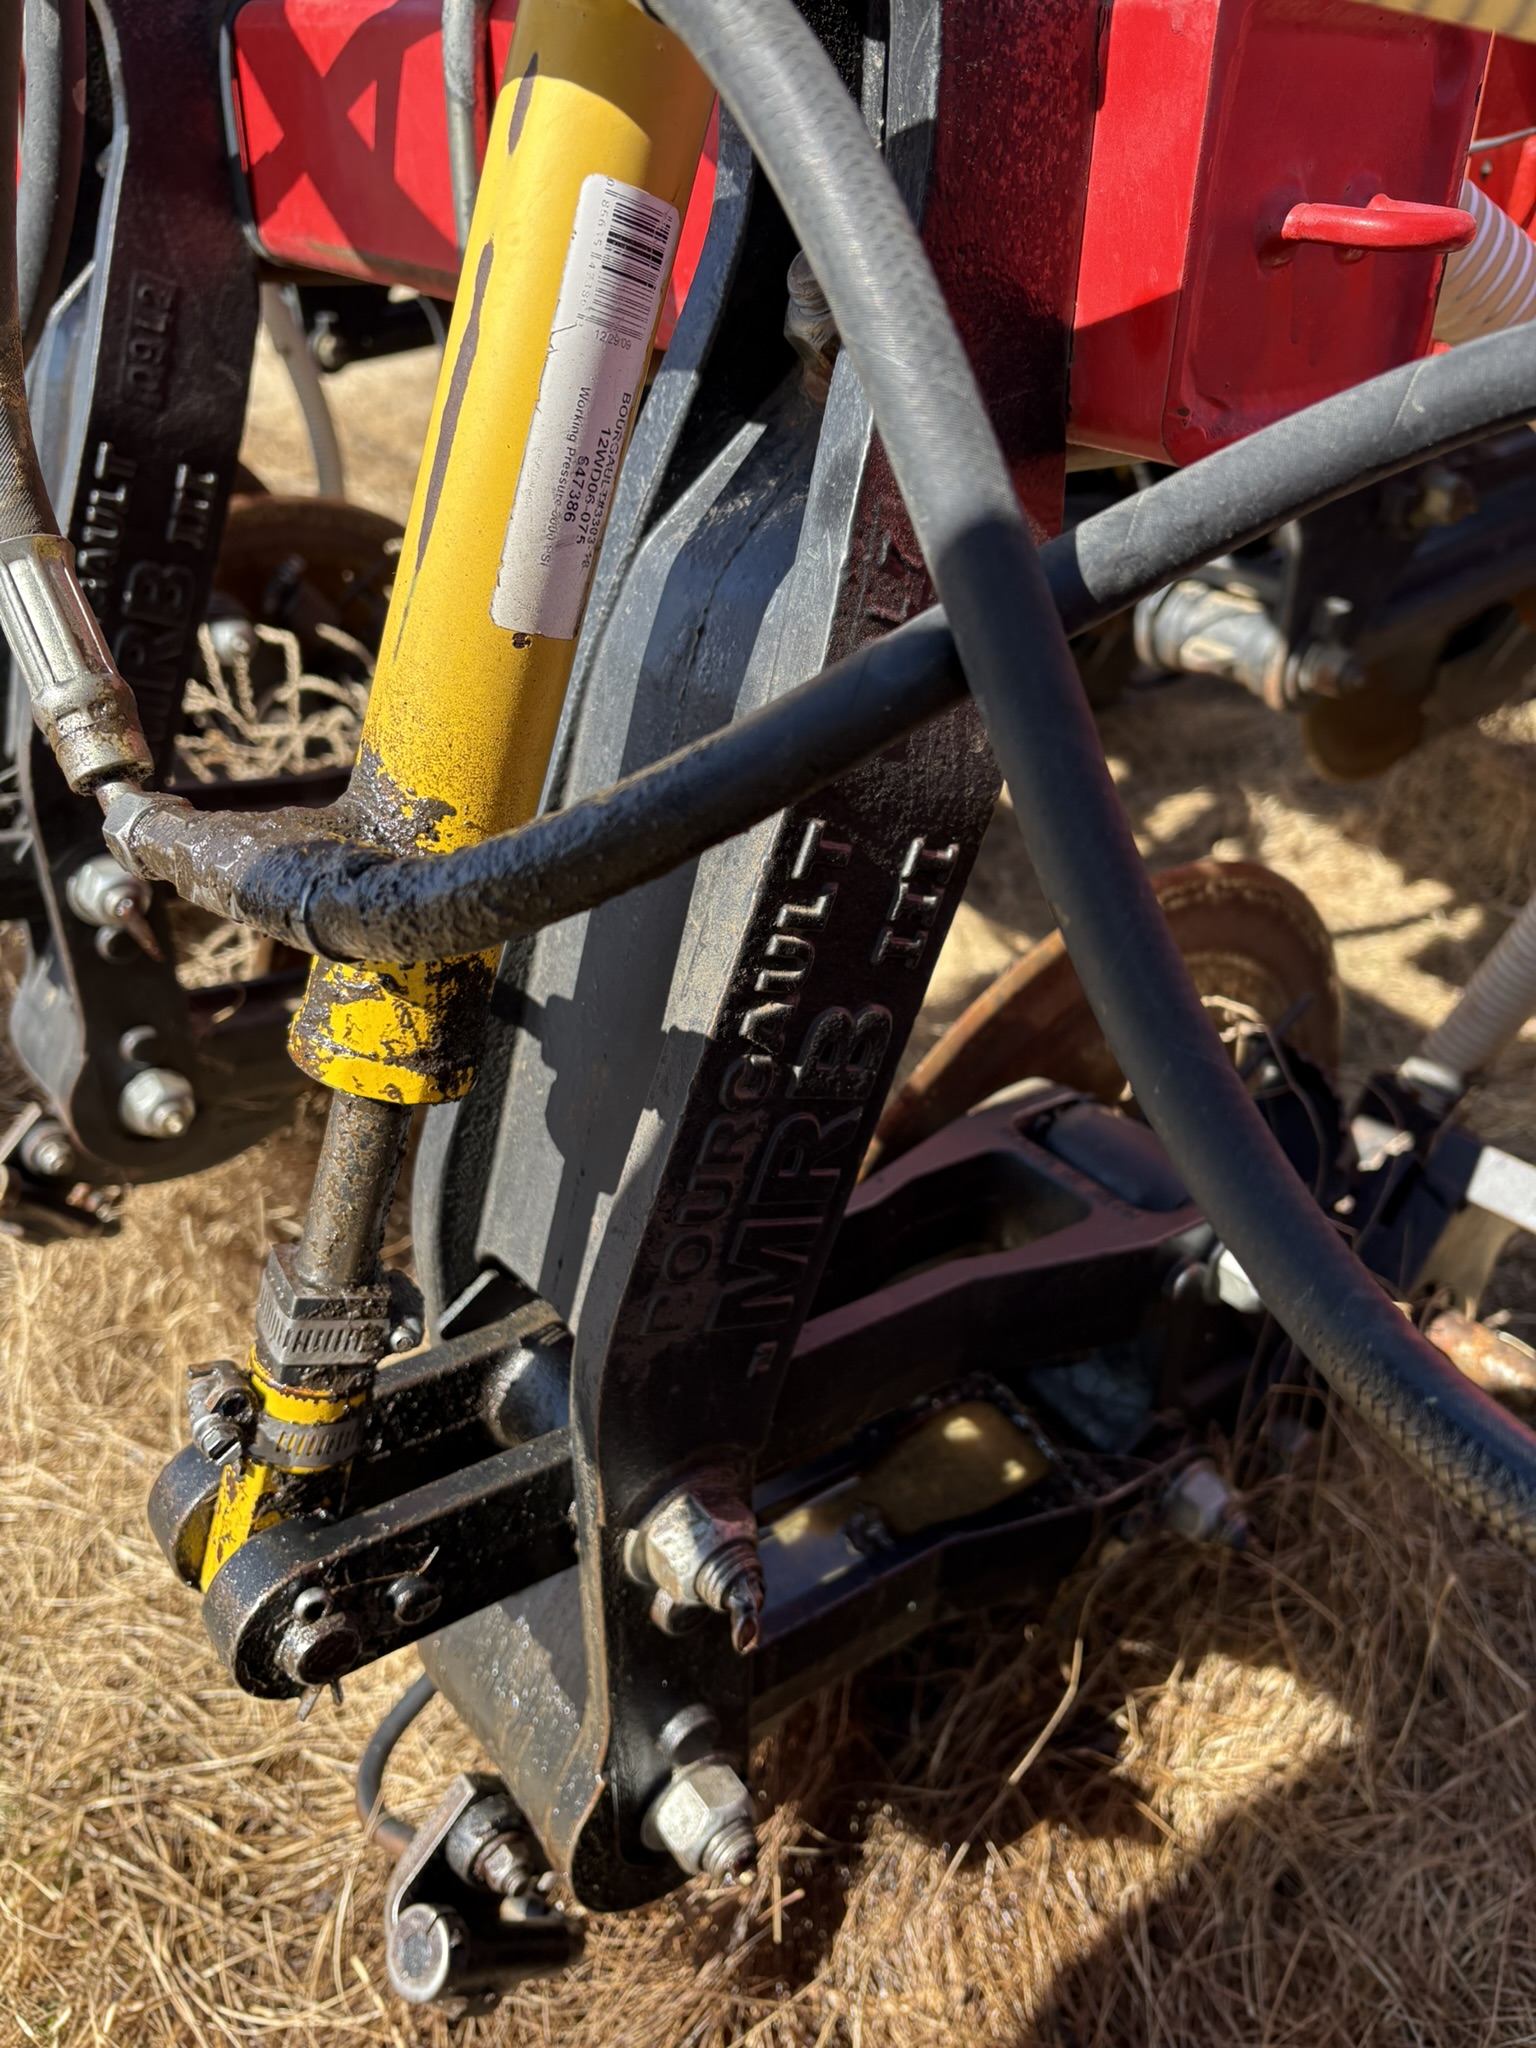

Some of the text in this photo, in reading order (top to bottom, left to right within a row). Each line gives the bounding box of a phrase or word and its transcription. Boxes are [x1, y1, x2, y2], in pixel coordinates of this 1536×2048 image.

[567, 386, 590, 442] Working
[552, 447, 576, 507] Pressure
[562, 455, 590, 523] 647386
[576, 427, 611, 545] 12WD06-075
[539, 545, 553, 567] PSI
[870, 835, 960, 970] III
[638, 817, 854, 1335] BOURGAULT
